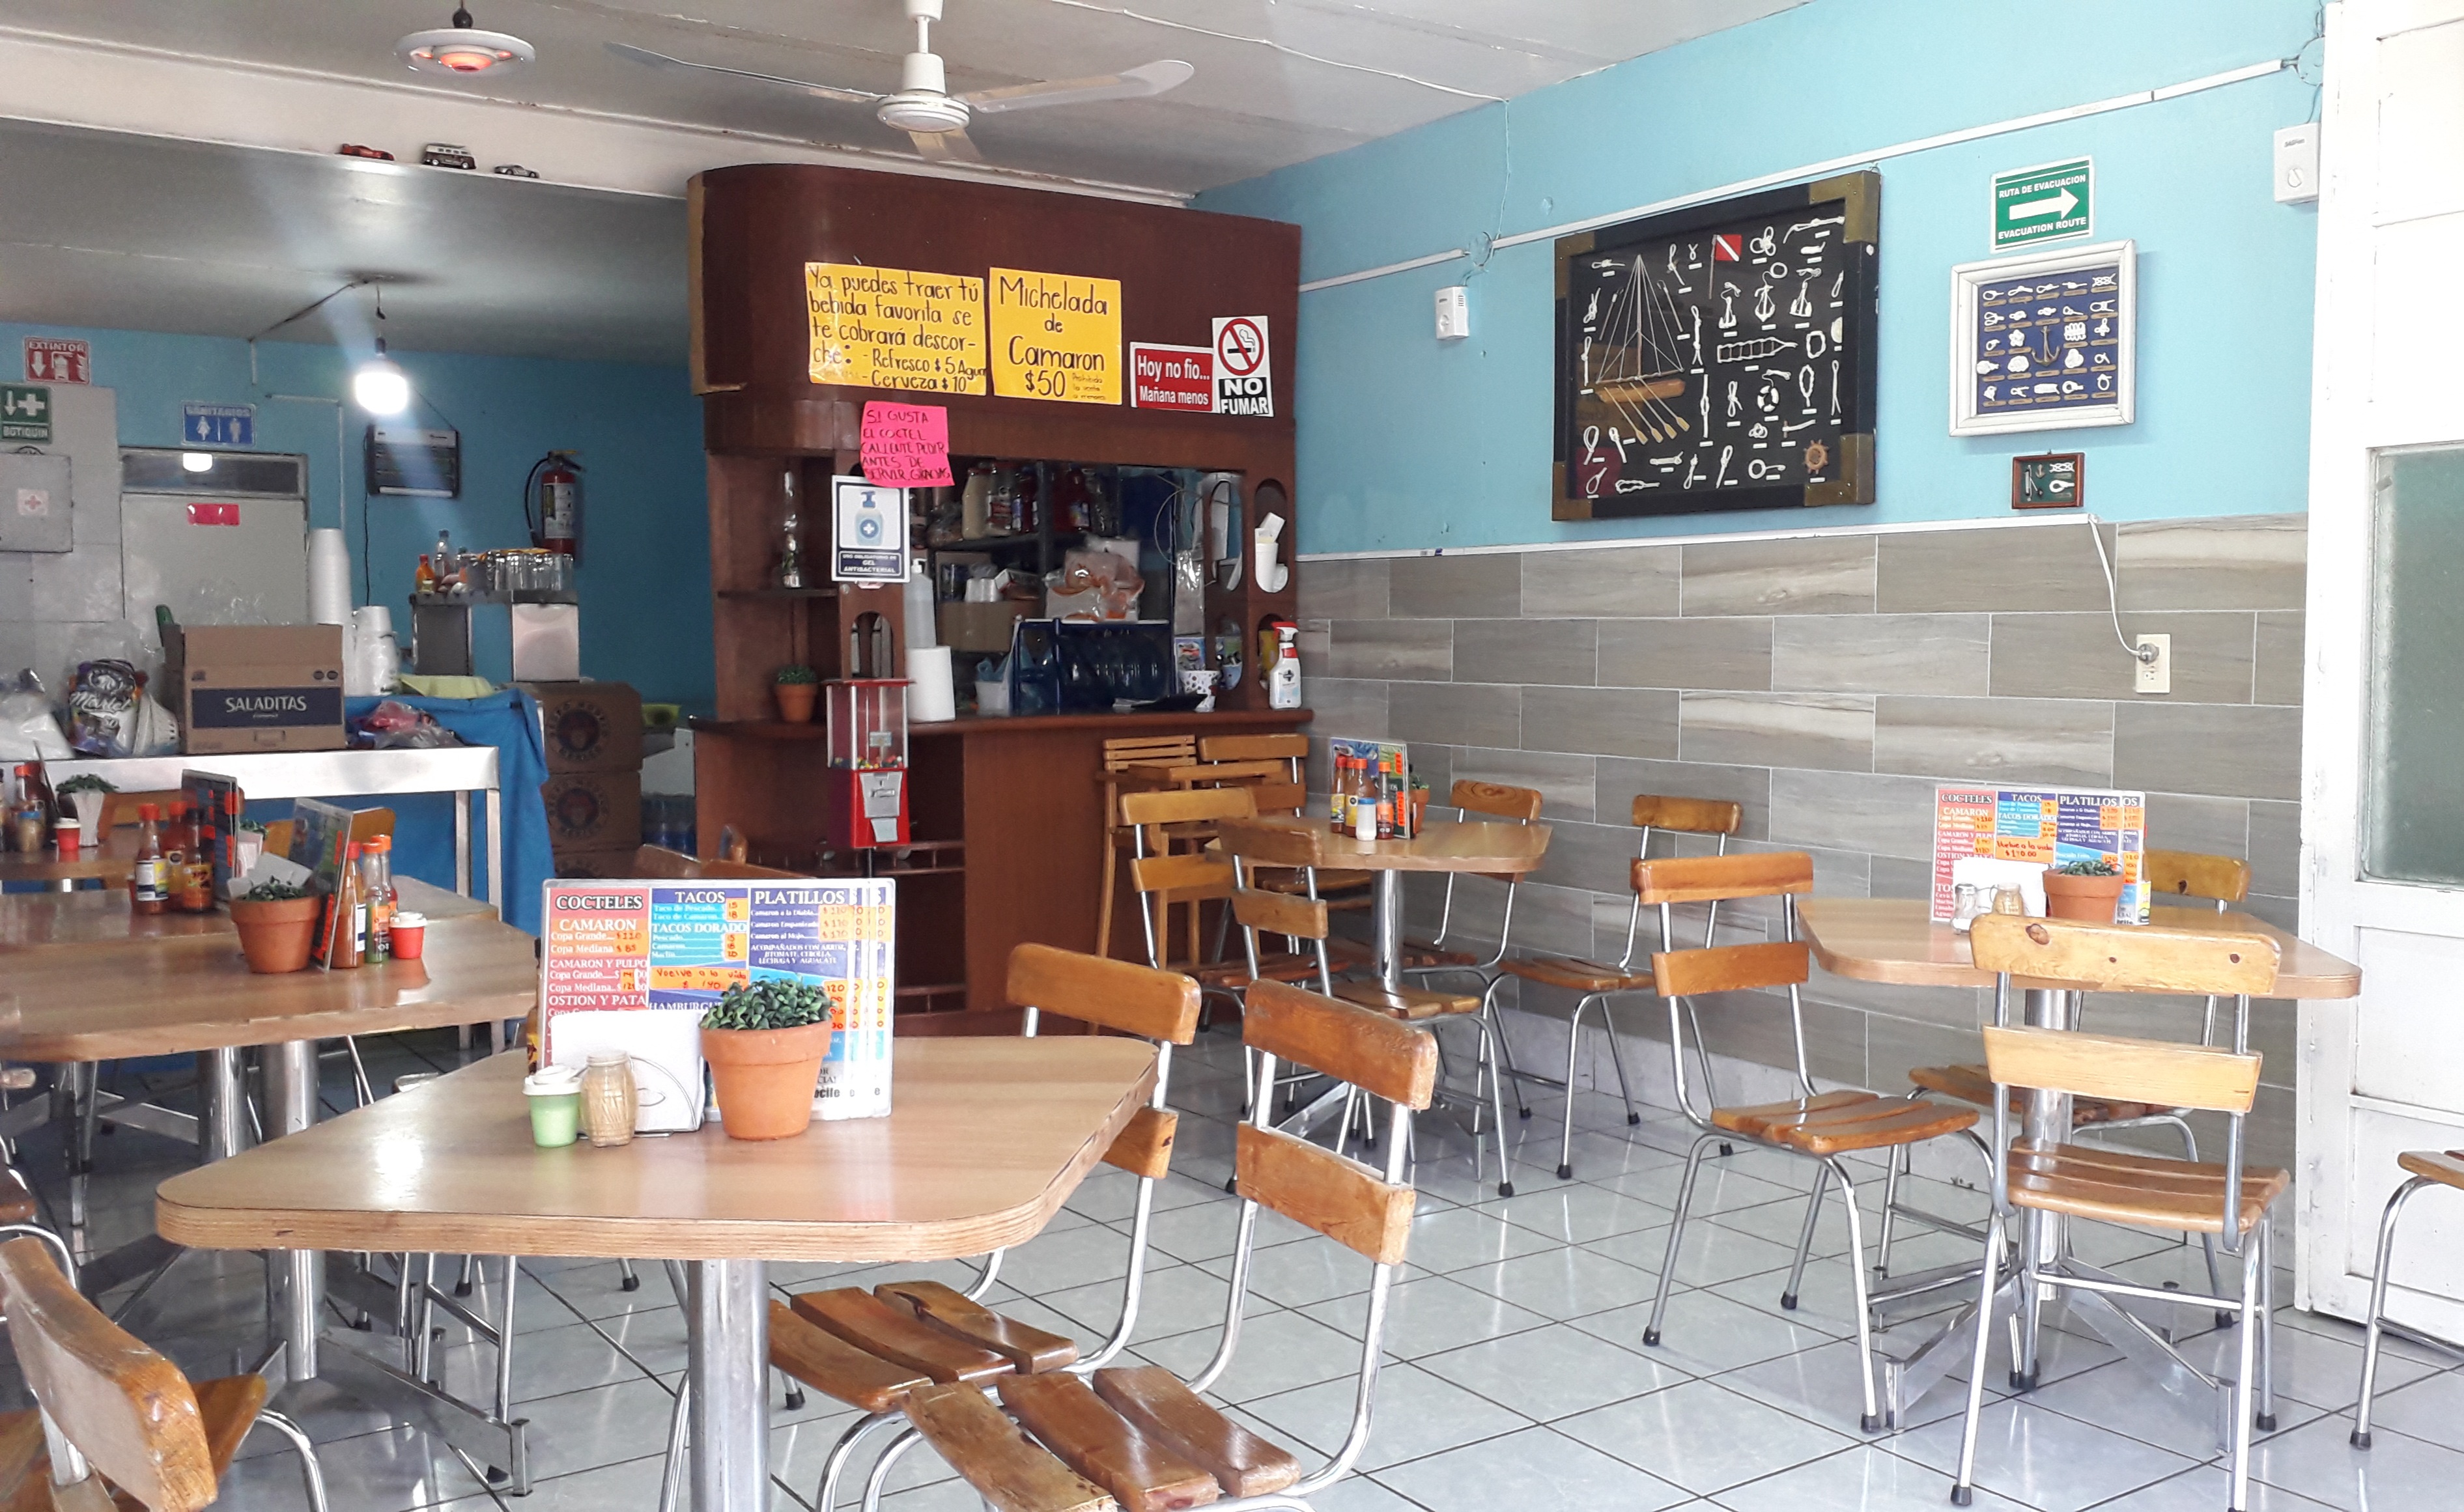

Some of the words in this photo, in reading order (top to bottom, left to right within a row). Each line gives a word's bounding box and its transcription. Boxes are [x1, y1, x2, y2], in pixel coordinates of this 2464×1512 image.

[1999, 188, 2019, 198] RUTA
[2022, 185, 2032, 193] DE
[2034, 175, 2086, 191] EVACUACION
[1998, 222, 2053, 240] EVACUATION
[2056, 217, 2086, 229] ROUTE
[809, 266, 832, 288] Ya
[842, 270, 898, 296] puedes
[903, 272, 953, 300] traer
[999, 275, 1107, 315] Michelada
[809, 290, 867, 316] bebida
[875, 294, 942, 323] favorita
[952, 309, 972, 326] se
[1044, 312, 1063, 333] de
[812, 316, 832, 338] te
[839, 319, 906, 346] cobrará
[29, 341, 87, 352] EXTINTOR
[1009, 335, 1105, 371] Camaron
[872, 348, 929, 372] Refresco
[1137, 354, 1161, 382] Hoy
[1165, 361, 1180, 378] no
[871, 370, 938, 389] Cerveza
[1025, 369, 1066, 398] $50
[1224, 378, 1263, 395] NO
[1139, 385, 1176, 404] Mañana
[1178, 391, 1208, 405] menos
[1221, 397, 1269, 415] FUMAR
[867, 410, 882, 423] SI
[888, 411, 929, 423] GUSTA
[3, 426, 48, 439] BOTIQUIN
[880, 428, 926, 440] COCTEL
[862, 456, 901, 468] ANTES
[906, 456, 924, 468] DE
[225, 695, 307, 713] SALADITAS
[1942, 794, 1992, 804] COCTELES
[2060, 796, 2117, 806] PLATILLOS
[1944, 807, 1988, 816] CAMARON
[556, 895, 643, 910] COCTELES
[675, 891, 726, 903] TACOS
[755, 891, 845, 904] PLATILLOS
[559, 919, 636, 931] CAMARON
[652, 923, 692, 932] TACOS
[550, 932, 573, 942] Copa
[550, 945, 573, 955] Copa
[576, 944, 614, 953] Mediana
[550, 959, 603, 968] CAMARON
[606, 959, 614, 968] Y
[550, 970, 571, 981] Copa
[549, 983, 571, 993] Copa
[549, 995, 597, 1005] OSTION
[599, 995, 608, 1005] Y
[612, 995, 647, 1005] PATA
